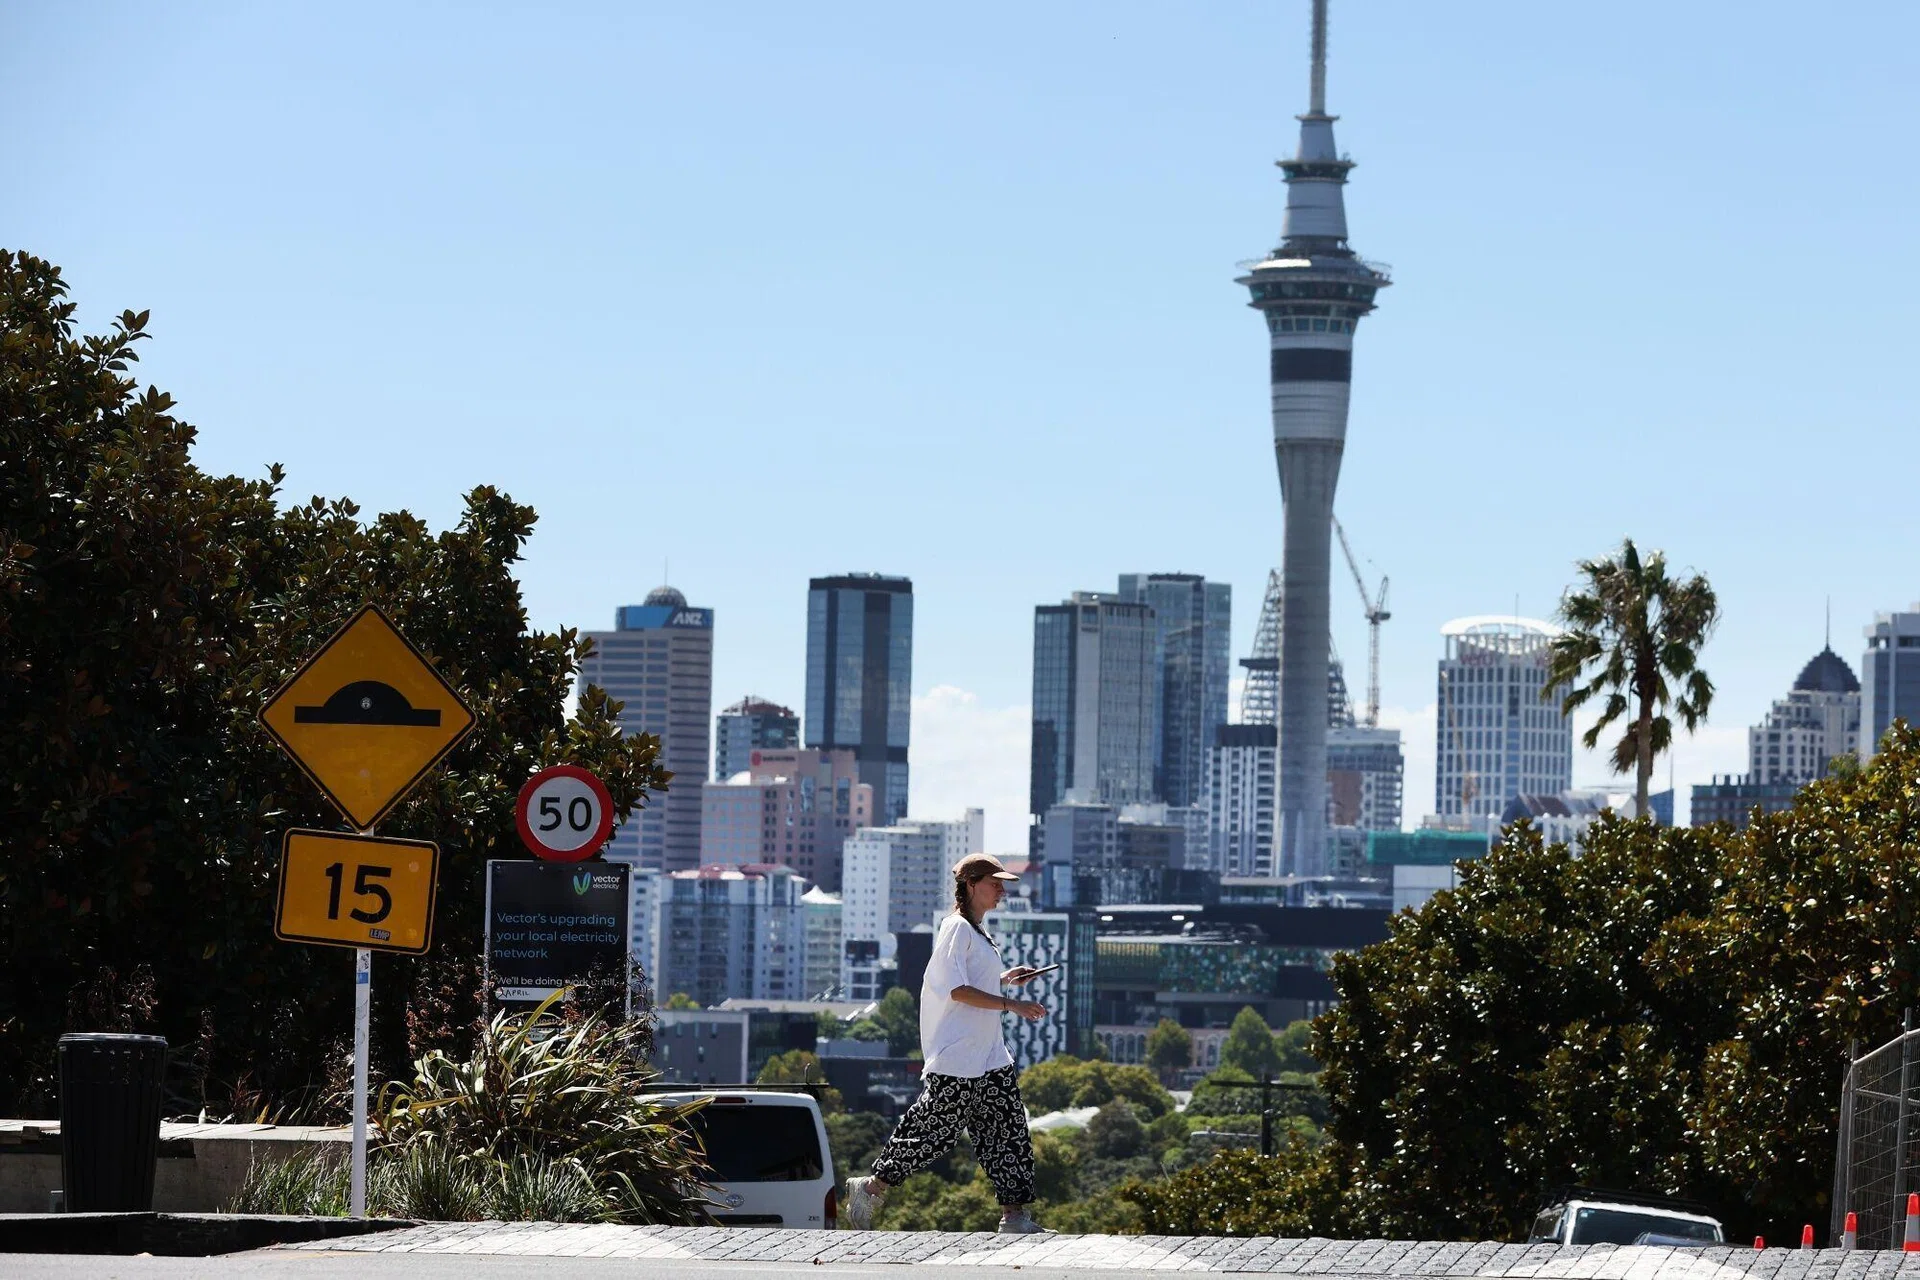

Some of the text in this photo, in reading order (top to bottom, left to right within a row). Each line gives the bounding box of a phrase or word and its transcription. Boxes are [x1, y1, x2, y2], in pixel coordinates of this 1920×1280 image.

[672, 611, 703, 626] ANZ
[538, 796, 593, 832] 50
[592, 875, 621, 883] vector
[325, 862, 392, 924] 15
[550, 914, 616, 927] upgrading
[496, 930, 620, 945] your local electricity
[495, 948, 549, 959] network
[520, 976, 533, 985] be
[535, 976, 563, 988] doing
[591, 977, 615, 986] utill
[505, 988, 530, 997] APRIL
